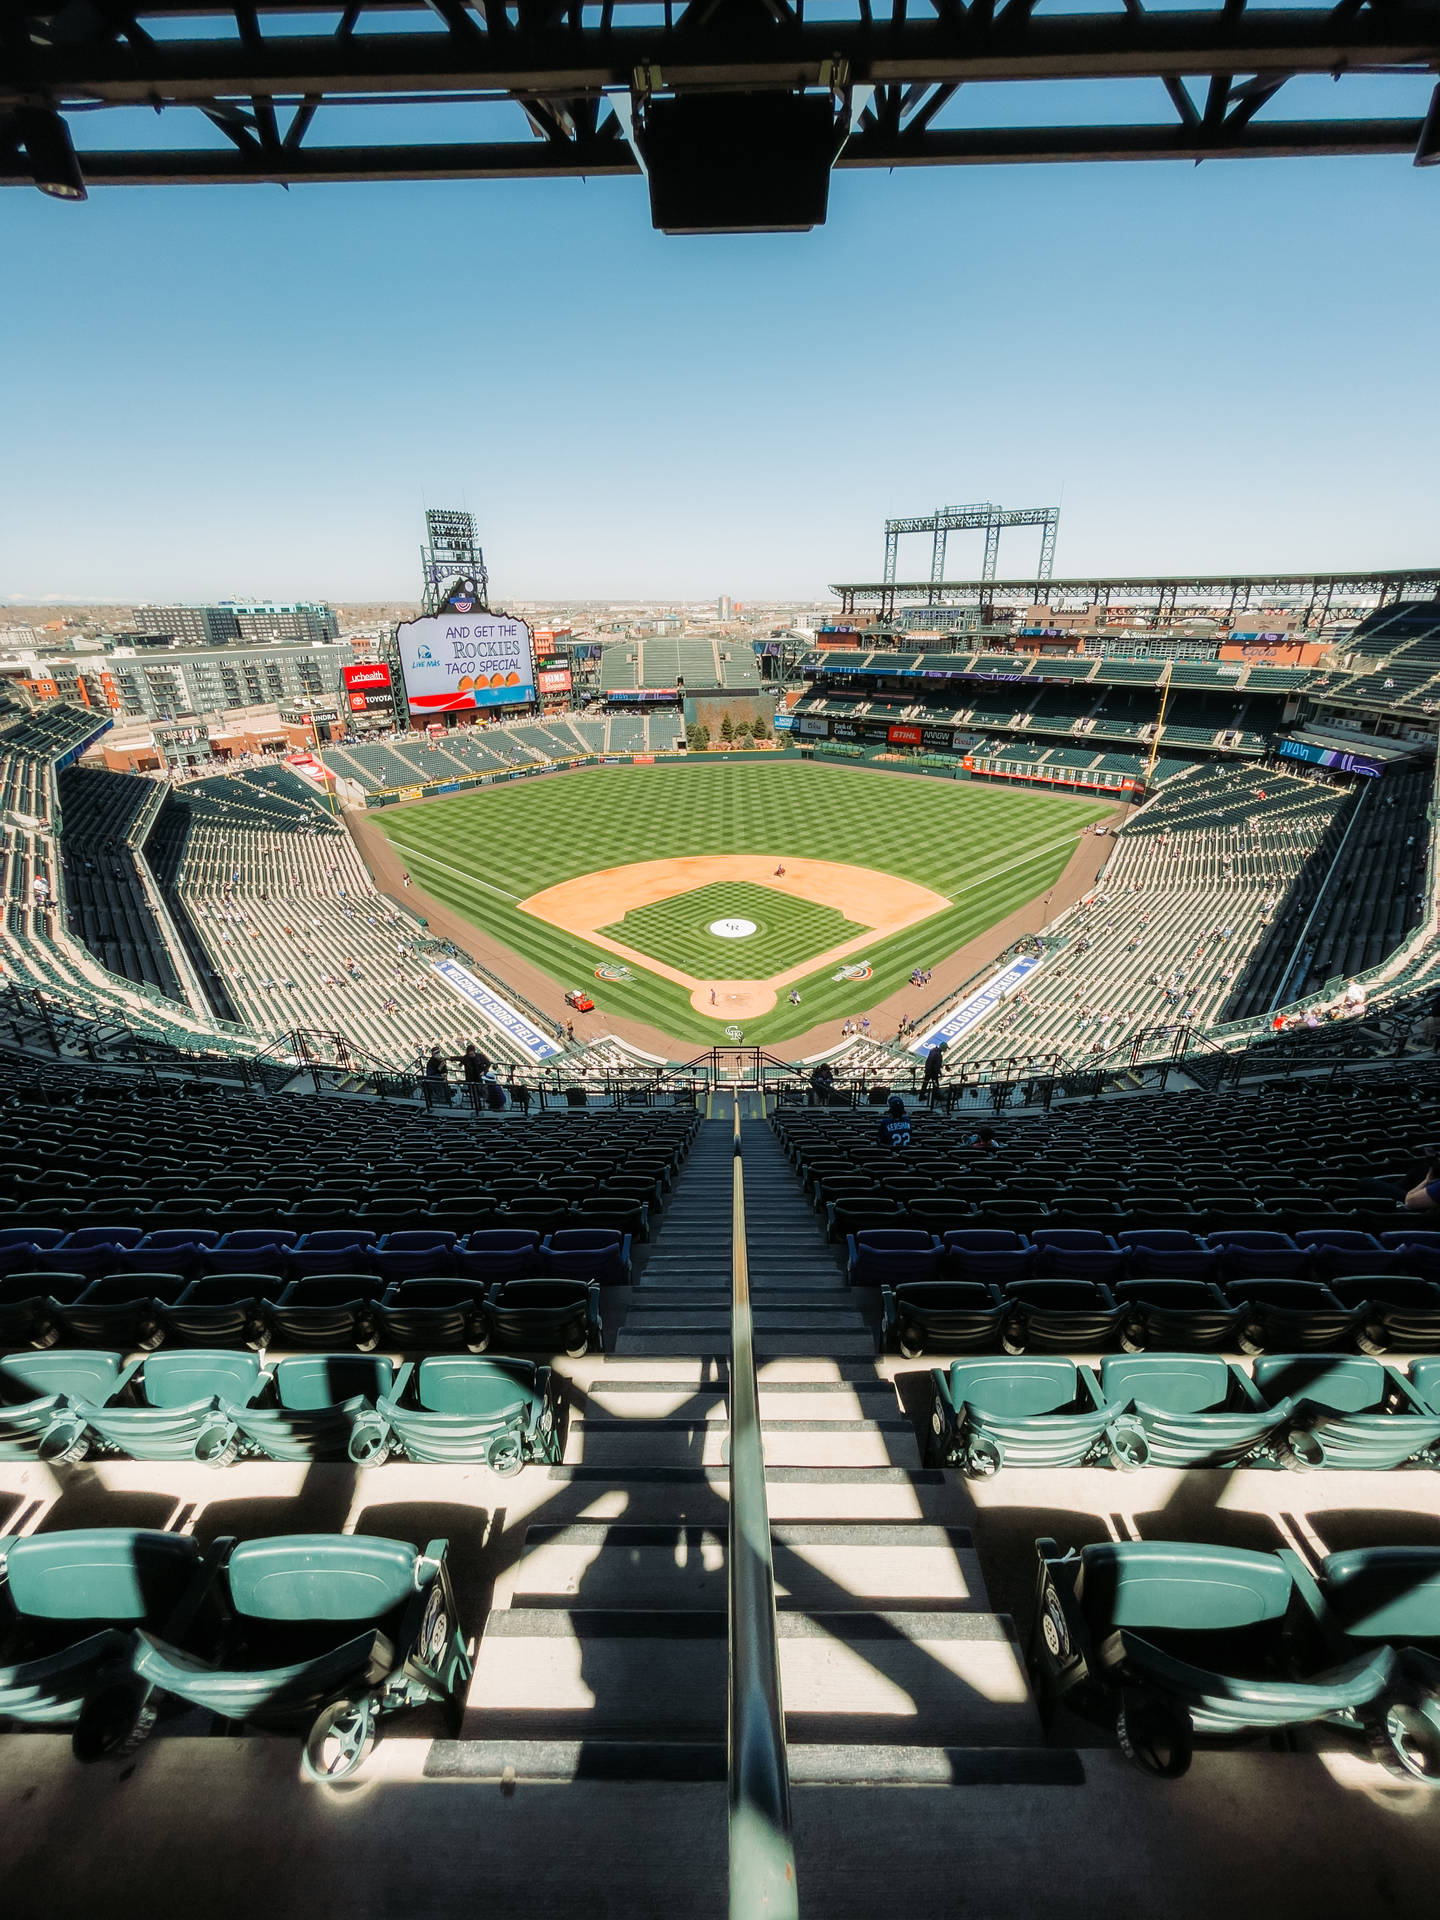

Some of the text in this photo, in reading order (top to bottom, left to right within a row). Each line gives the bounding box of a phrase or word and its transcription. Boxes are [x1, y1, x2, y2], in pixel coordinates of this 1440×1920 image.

[446, 624, 517, 639] AND GET THE
[452, 640, 521, 659] ROCKIES
[1242, 646, 1277, 657] Coors
[445, 658, 521, 675] TACO SPECIAL
[351, 670, 384, 682] uchealth
[365, 694, 393, 704] TOYOTA
[309, 713, 337, 723] TUNDRA
[834, 728, 857, 737] Colorado
[892, 730, 917, 740] STIHL
[445, 969, 539, 1045] WELCOME TO COORS FIELD
[940, 971, 1022, 1036] COLORADO ROCKIES
[891, 1132, 910, 1147] 22
